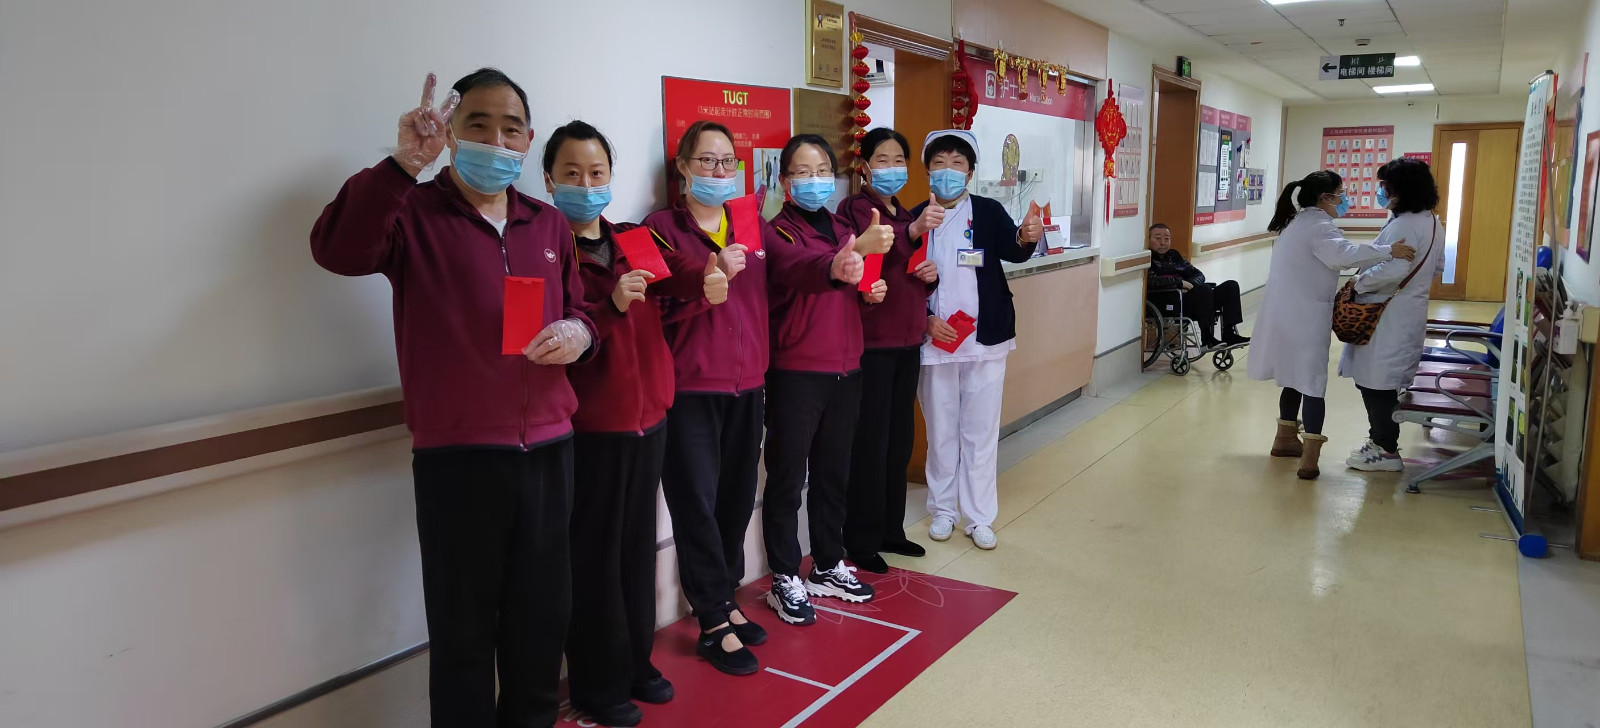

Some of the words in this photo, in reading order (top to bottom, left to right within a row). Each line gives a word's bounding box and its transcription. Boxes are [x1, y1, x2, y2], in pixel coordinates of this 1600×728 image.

[1340, 67, 1365, 77] 电梯间
[1367, 65, 1394, 76] 楼梯间
[722, 90, 749, 106] TUGT
